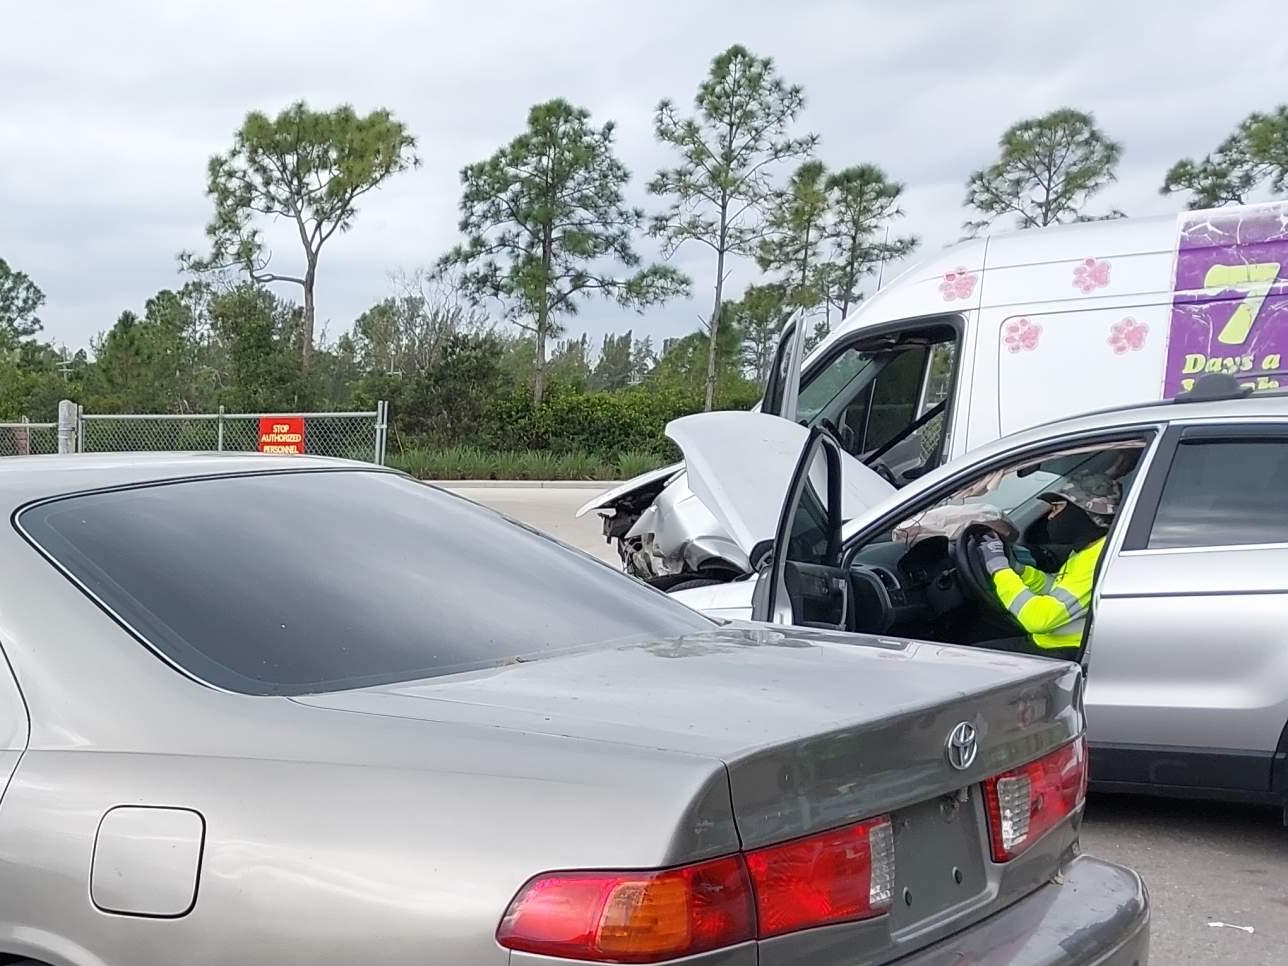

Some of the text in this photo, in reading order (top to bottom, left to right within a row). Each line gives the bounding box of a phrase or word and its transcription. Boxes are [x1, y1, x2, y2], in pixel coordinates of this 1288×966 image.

[1203, 262, 1280, 345] 7
[1182, 353, 1281, 374] Days a
[273, 424, 290, 433] STOP
[261, 433, 302, 442] AUTHORIZED
